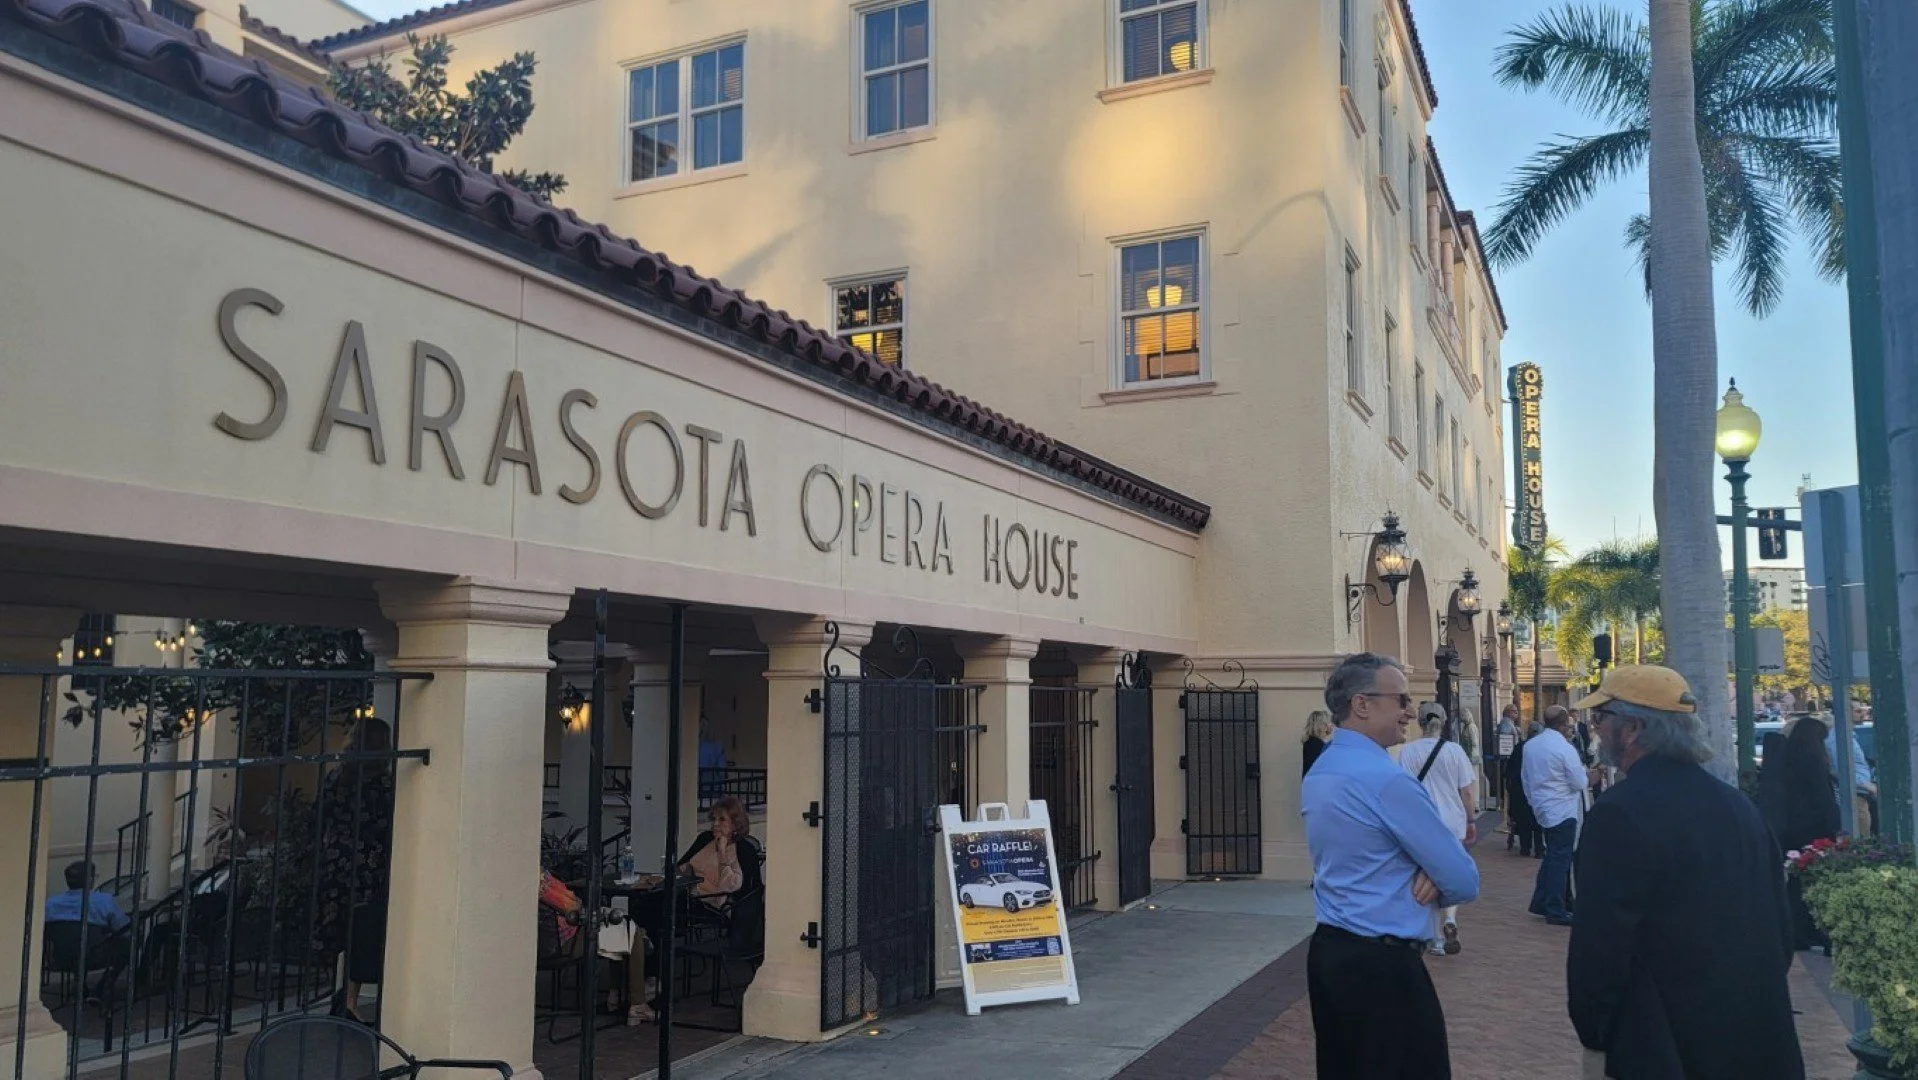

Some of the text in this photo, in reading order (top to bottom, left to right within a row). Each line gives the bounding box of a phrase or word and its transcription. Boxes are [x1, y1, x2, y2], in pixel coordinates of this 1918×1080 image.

[216, 288, 1080, 600] SARASOTA OPERA HOUSE
[1525, 368, 1543, 542] OPERA HOUSE
[968, 841, 1033, 854] CAR RAFFLE!
